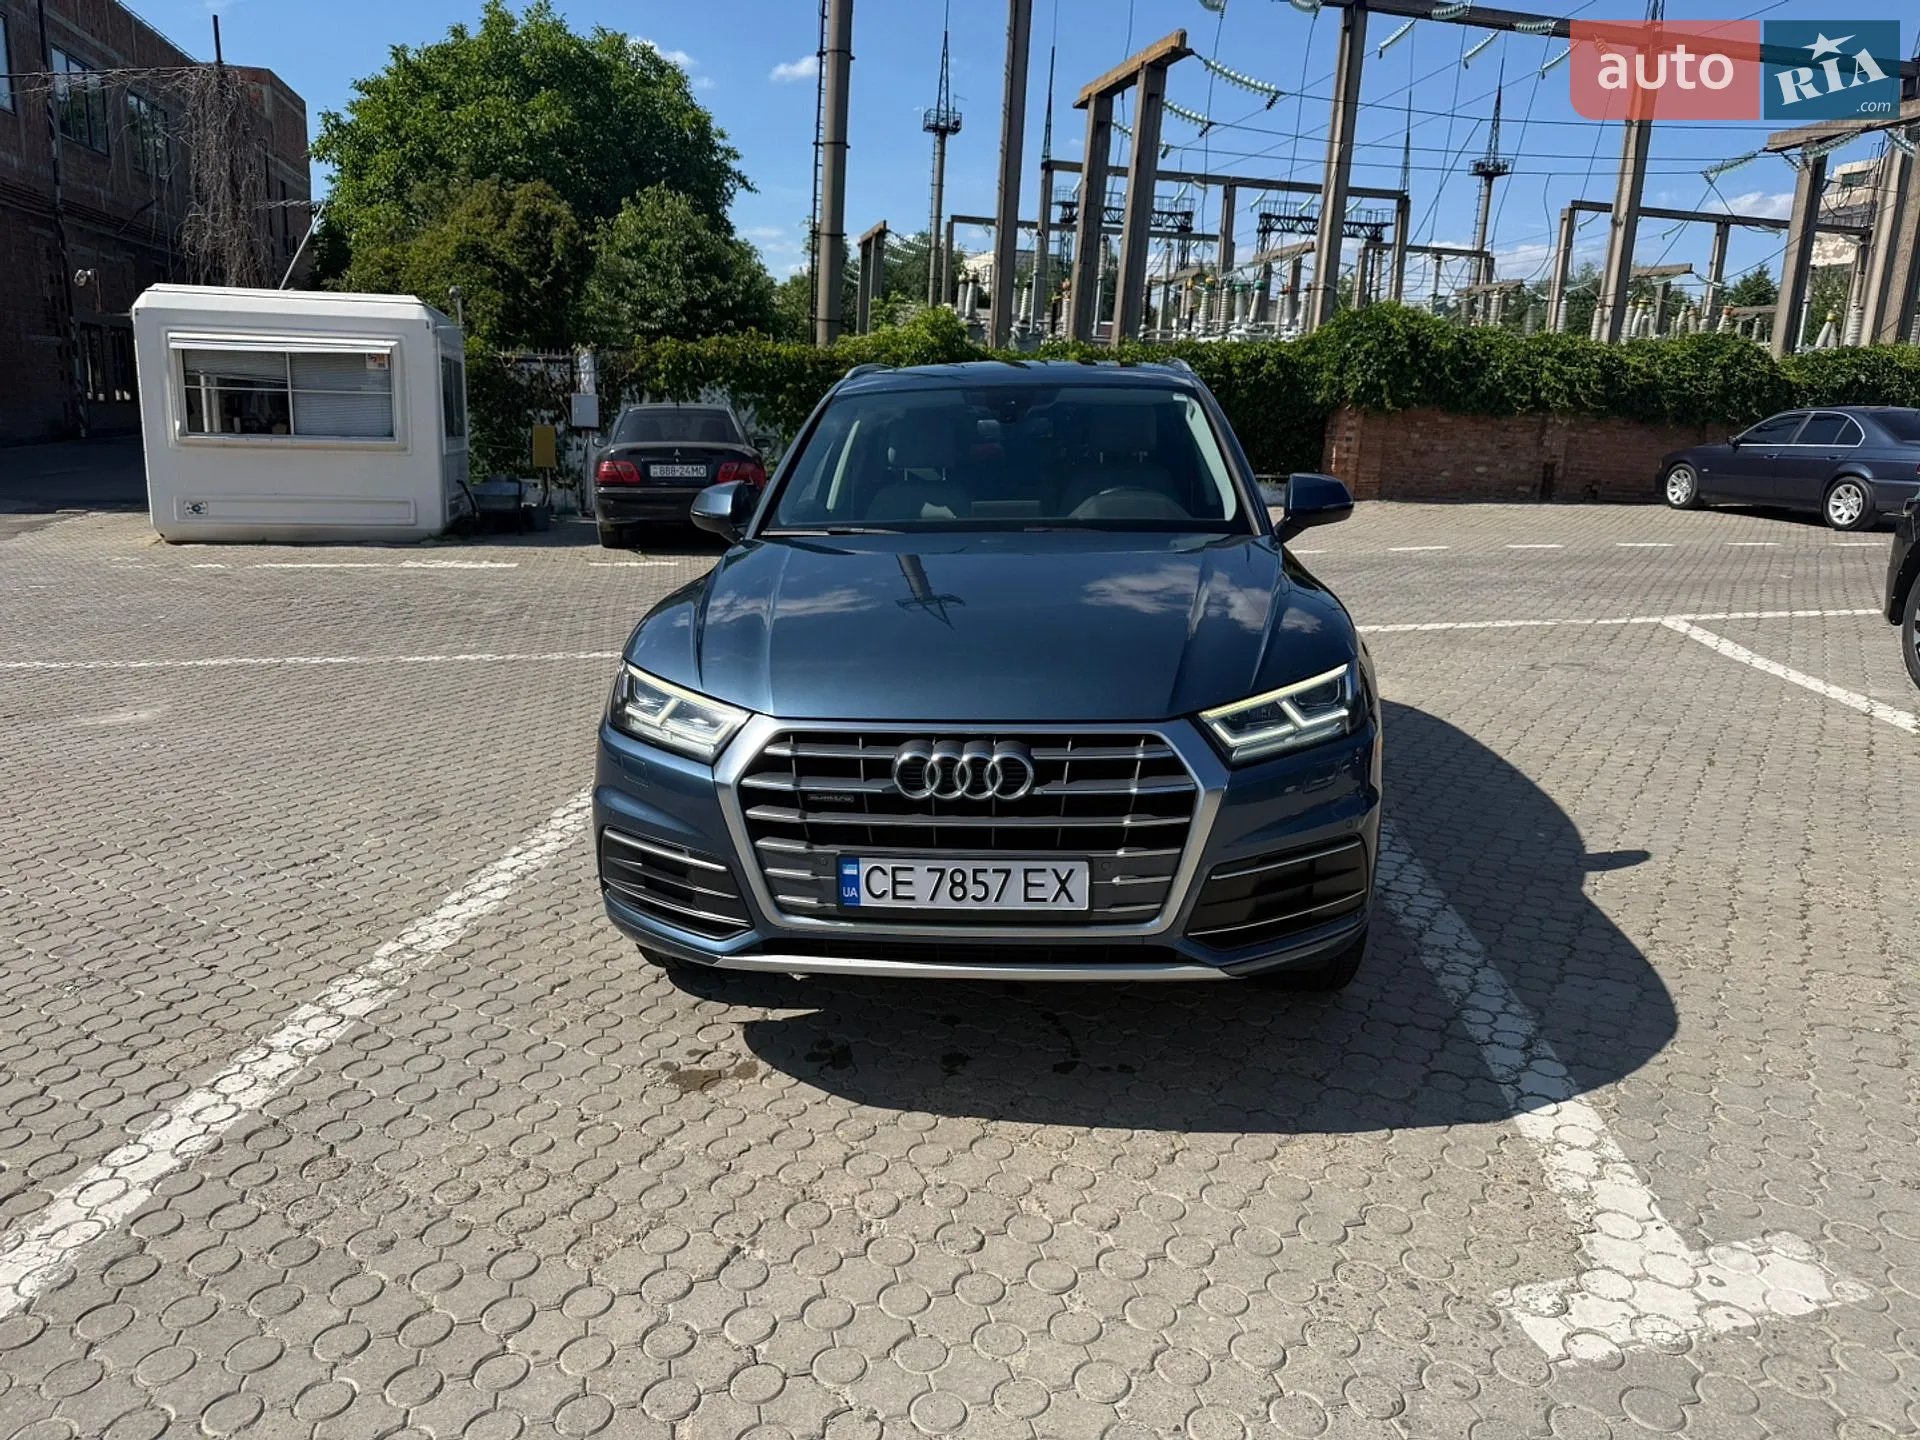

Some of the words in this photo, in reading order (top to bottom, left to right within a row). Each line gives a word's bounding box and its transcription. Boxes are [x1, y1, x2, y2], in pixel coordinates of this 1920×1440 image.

[842, 886, 858, 897] UA
[864, 864, 915, 901] CE
[926, 867, 1012, 902] 7857
[1022, 868, 1076, 903] EX
